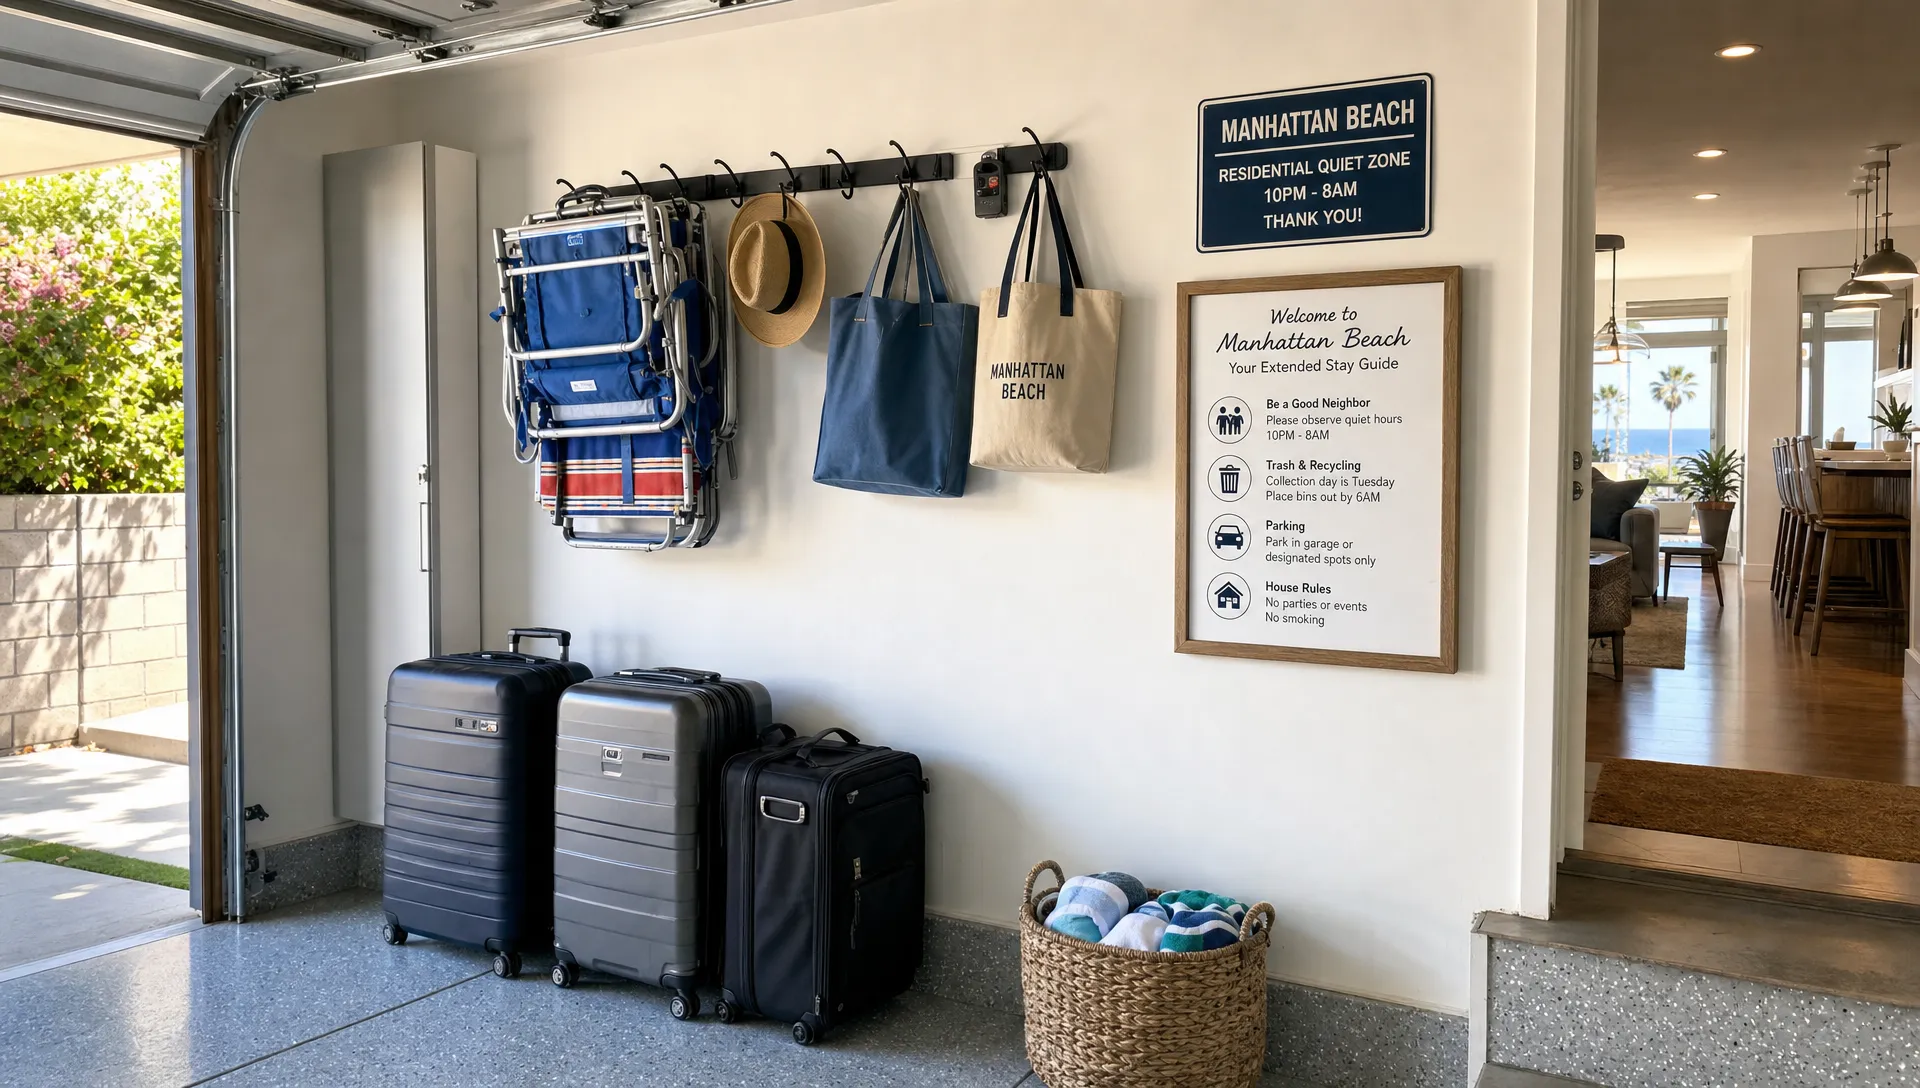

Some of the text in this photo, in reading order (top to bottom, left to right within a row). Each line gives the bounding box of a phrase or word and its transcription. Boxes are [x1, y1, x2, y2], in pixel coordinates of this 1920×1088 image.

[1221, 98, 1414, 143] MANHATTAN BEACH
[1219, 151, 1410, 182] RESIDENTIAL QUIET ZONE
[1264, 185, 1306, 203] 10PM
[1322, 181, 1357, 198] 8AM
[1263, 207, 1362, 229] THANK YOU!
[1270, 306, 1357, 324] Welcome to
[1215, 326, 1411, 353] Manhattan Beach
[990, 362, 1064, 379] MANHATTAN
[1228, 357, 1399, 374] Your Extended Stay Guide
[1001, 383, 1045, 399] BEACH
[1266, 398, 1370, 410] Be a Good Neighbor
[1266, 414, 1402, 426] Please observe quiet hours
[1266, 430, 1295, 440] 10PM
[1305, 430, 1329, 440] 8AM
[1266, 460, 1361, 472] Trash & Recycling
[1265, 475, 1395, 489] Collection day is Tuesday
[1265, 491, 1380, 504] Place bins out by 6AM
[1265, 520, 1305, 533] Parking
[1265, 537, 1353, 551] Park in garage or
[1265, 552, 1376, 568] designated spots only
[1265, 581, 1331, 594] House Rules
[1265, 597, 1367, 611] No parties or events
[1265, 612, 1324, 627] No smoking
